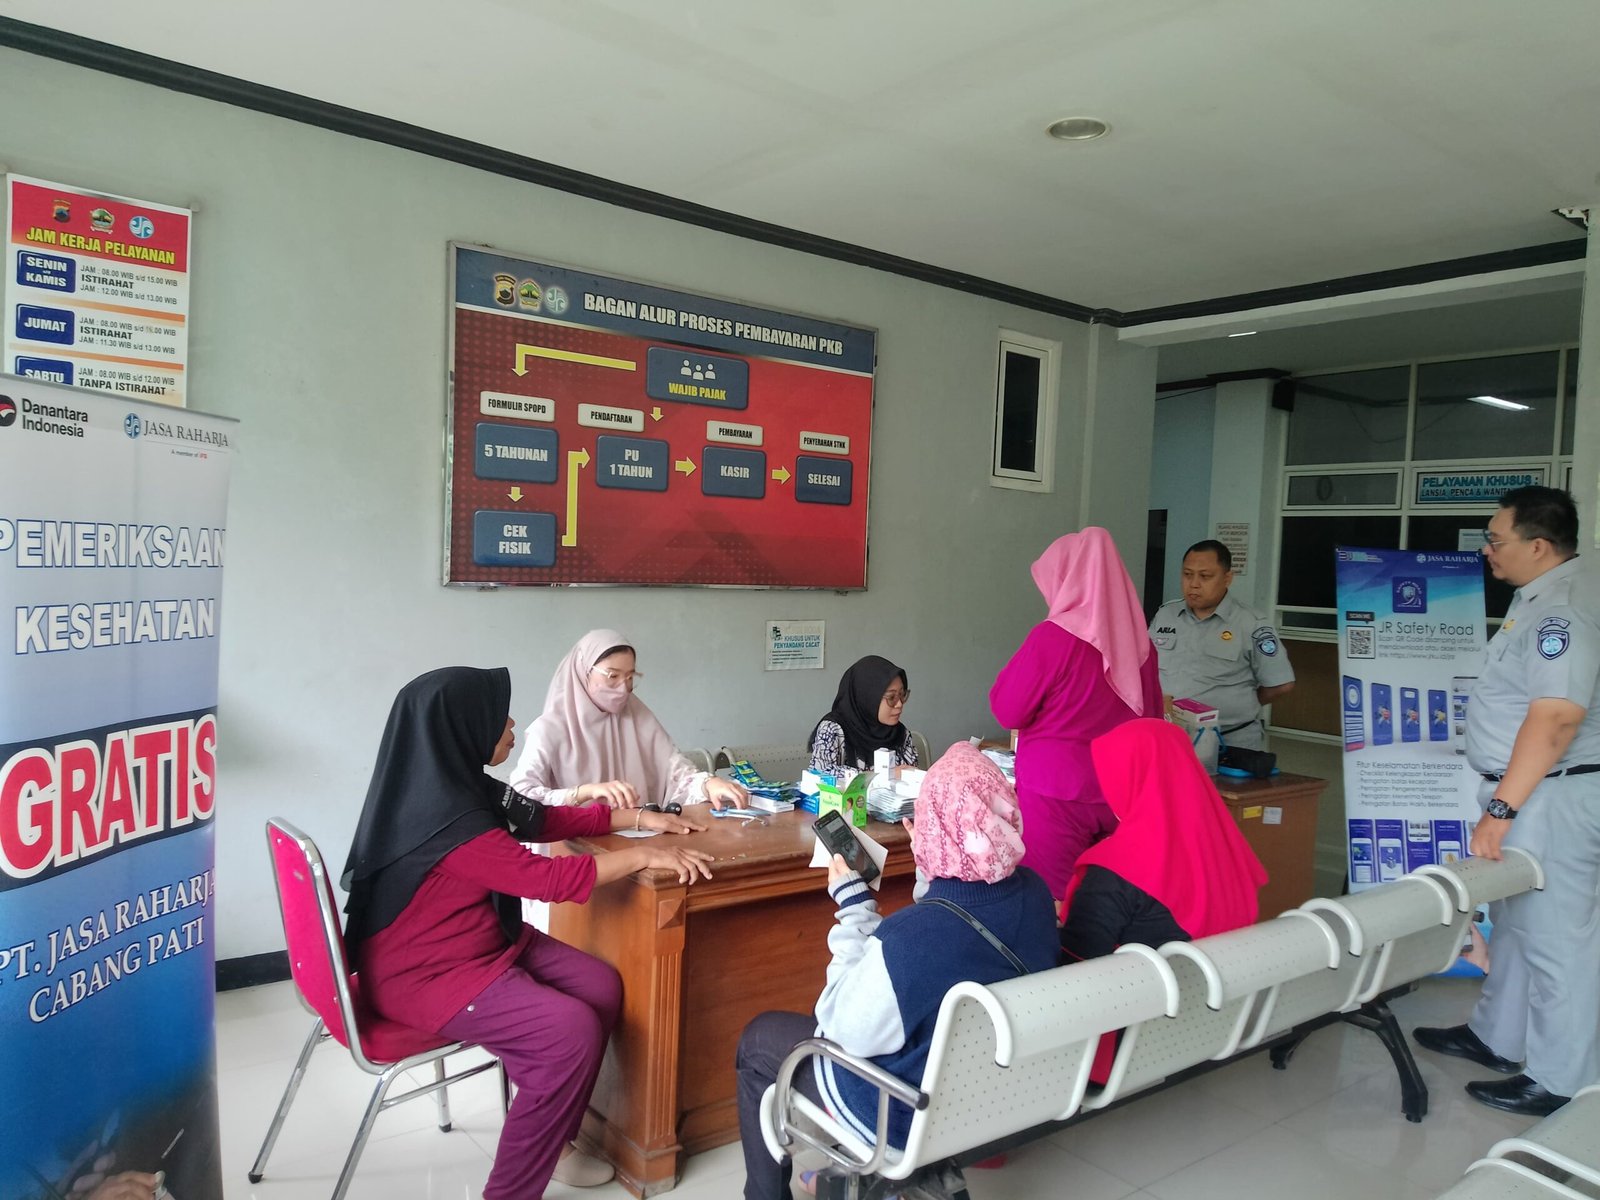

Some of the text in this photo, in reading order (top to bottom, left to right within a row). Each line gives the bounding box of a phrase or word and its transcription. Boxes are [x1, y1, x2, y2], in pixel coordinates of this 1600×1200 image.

[26, 227, 175, 265] JAM KERJA PELAYANAN
[26, 256, 67, 272] SENIN
[26, 272, 66, 287] KAMIS
[80, 265, 96, 274] JAM
[102, 268, 120, 278] 08.00
[121, 270, 134, 280] WIB
[136, 272, 145, 282] s/d
[147, 274, 163, 285] 15.00
[165, 276, 178, 286] WIB
[82, 274, 134, 289] ISTIRAHAT
[80, 284, 96, 294] JAM
[102, 287, 119, 296] 12.00
[120, 289, 134, 298] WIB
[135, 291, 145, 301] s/d
[146, 294, 163, 304] 13.00
[164, 296, 177, 305] WIB
[24, 317, 67, 332] JUMAT
[79, 317, 95, 326] JAM
[100, 320, 118, 329] 08.00
[119, 322, 132, 331] WIB
[134, 324, 144, 333] s/d
[163, 328, 176, 336] WIB
[584, 292, 843, 356] BAGAN ALUR PROSES PEMBAYARAN PKB
[80, 326, 133, 340] ISTIRAHAT
[79, 336, 95, 344] JAM
[100, 338, 117, 348] 11.30
[118, 341, 132, 350] WIB
[133, 342, 143, 351] s/d
[145, 345, 161, 353] 13.00
[162, 347, 175, 355] WIB
[25, 369, 64, 383] SABTU
[78, 367, 93, 376] JAM
[99, 370, 117, 379] 08.00
[118, 372, 130, 380] WIB
[133, 372, 142, 382] s/d
[144, 375, 161, 384] 12.00
[162, 377, 175, 385] WIB
[79, 378, 166, 396] TANPA ISTIRAHAT
[668, 382, 726, 400] WAJIB PAJAK
[22, 398, 88, 422] Danantara
[488, 398, 546, 414] FORMULIR SPOPD
[590, 411, 633, 424] PENDAFTARAN
[22, 416, 84, 438] Indonesia
[144, 420, 229, 447] JASA RAHARJA
[719, 427, 753, 439] PEMBAYARAN
[804, 437, 846, 449] PENYERAHAN STNK
[484, 444, 548, 462] 5 TAHUNAN
[624, 449, 640, 462] PU
[609, 464, 653, 479] 1 TAHUN
[720, 465, 750, 479] KASIR
[808, 473, 840, 486] SELESAI
[1422, 476, 1483, 488] PELAYANAN
[1486, 475, 1532, 486] KHUSUS
[1451, 488, 1474, 497] PENCA
[503, 524, 528, 538] CEK
[498, 541, 532, 554] FISIK
[16, 598, 214, 655] KESEHATAN
[1379, 622, 1474, 636] JR Safety Road
[1422, 762, 1463, 770] Berkendara
[0, 713, 218, 879] GRATIS
[48, 910, 110, 975] JASA
[28, 916, 205, 1024] CABANG PATI
